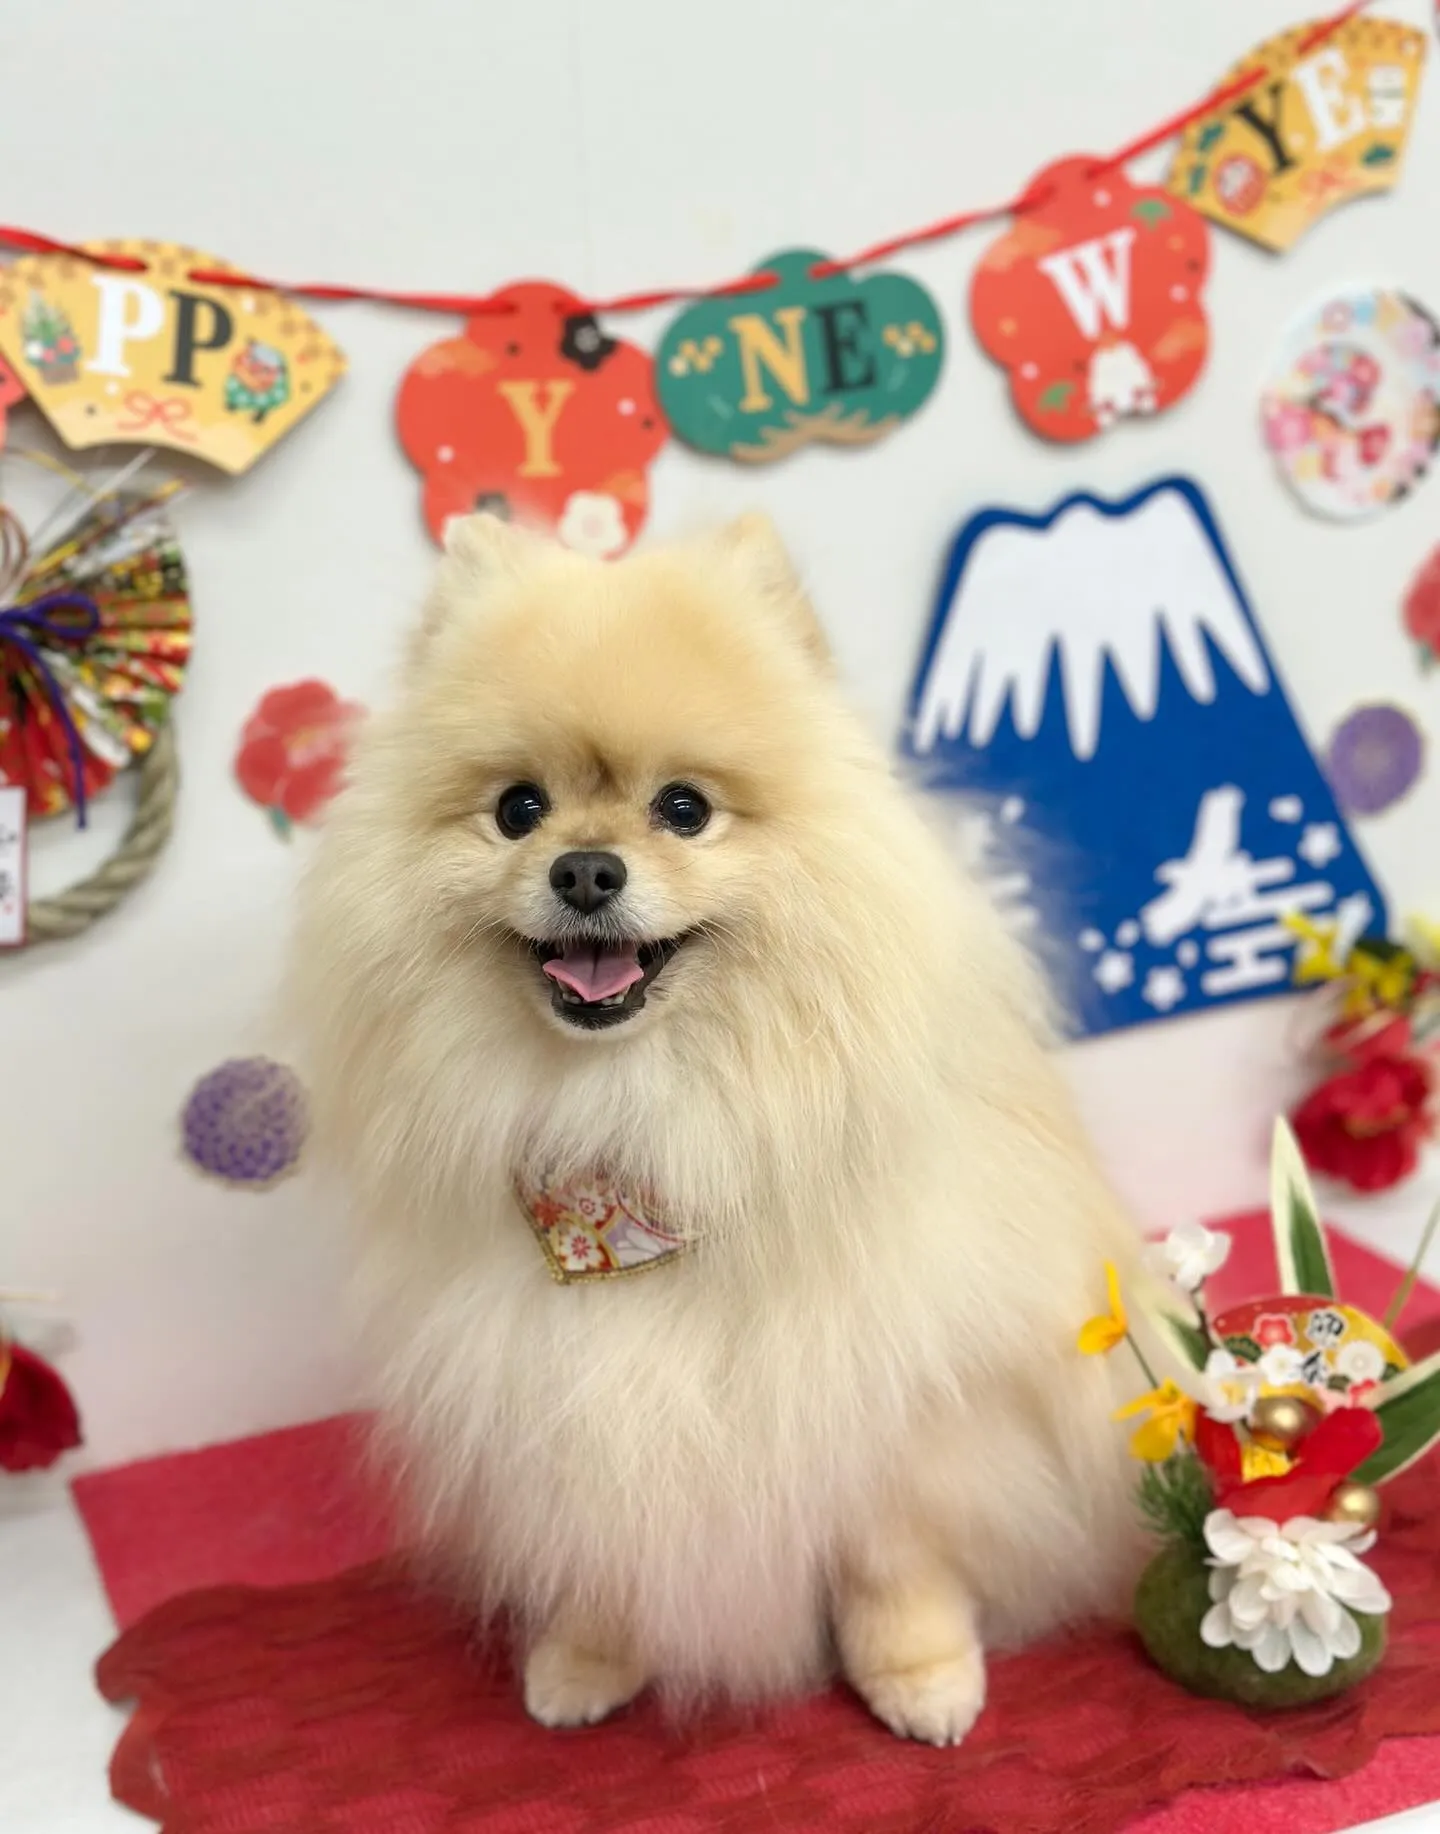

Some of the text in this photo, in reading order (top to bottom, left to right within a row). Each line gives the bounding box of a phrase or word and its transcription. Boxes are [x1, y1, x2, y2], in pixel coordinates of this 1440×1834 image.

[1232, 47, 1367, 176] YE
[84, 273, 235, 389] PP
[1038, 227, 1136, 340] W
[730, 298, 877, 412] NE
[496, 377, 575, 479] Y
